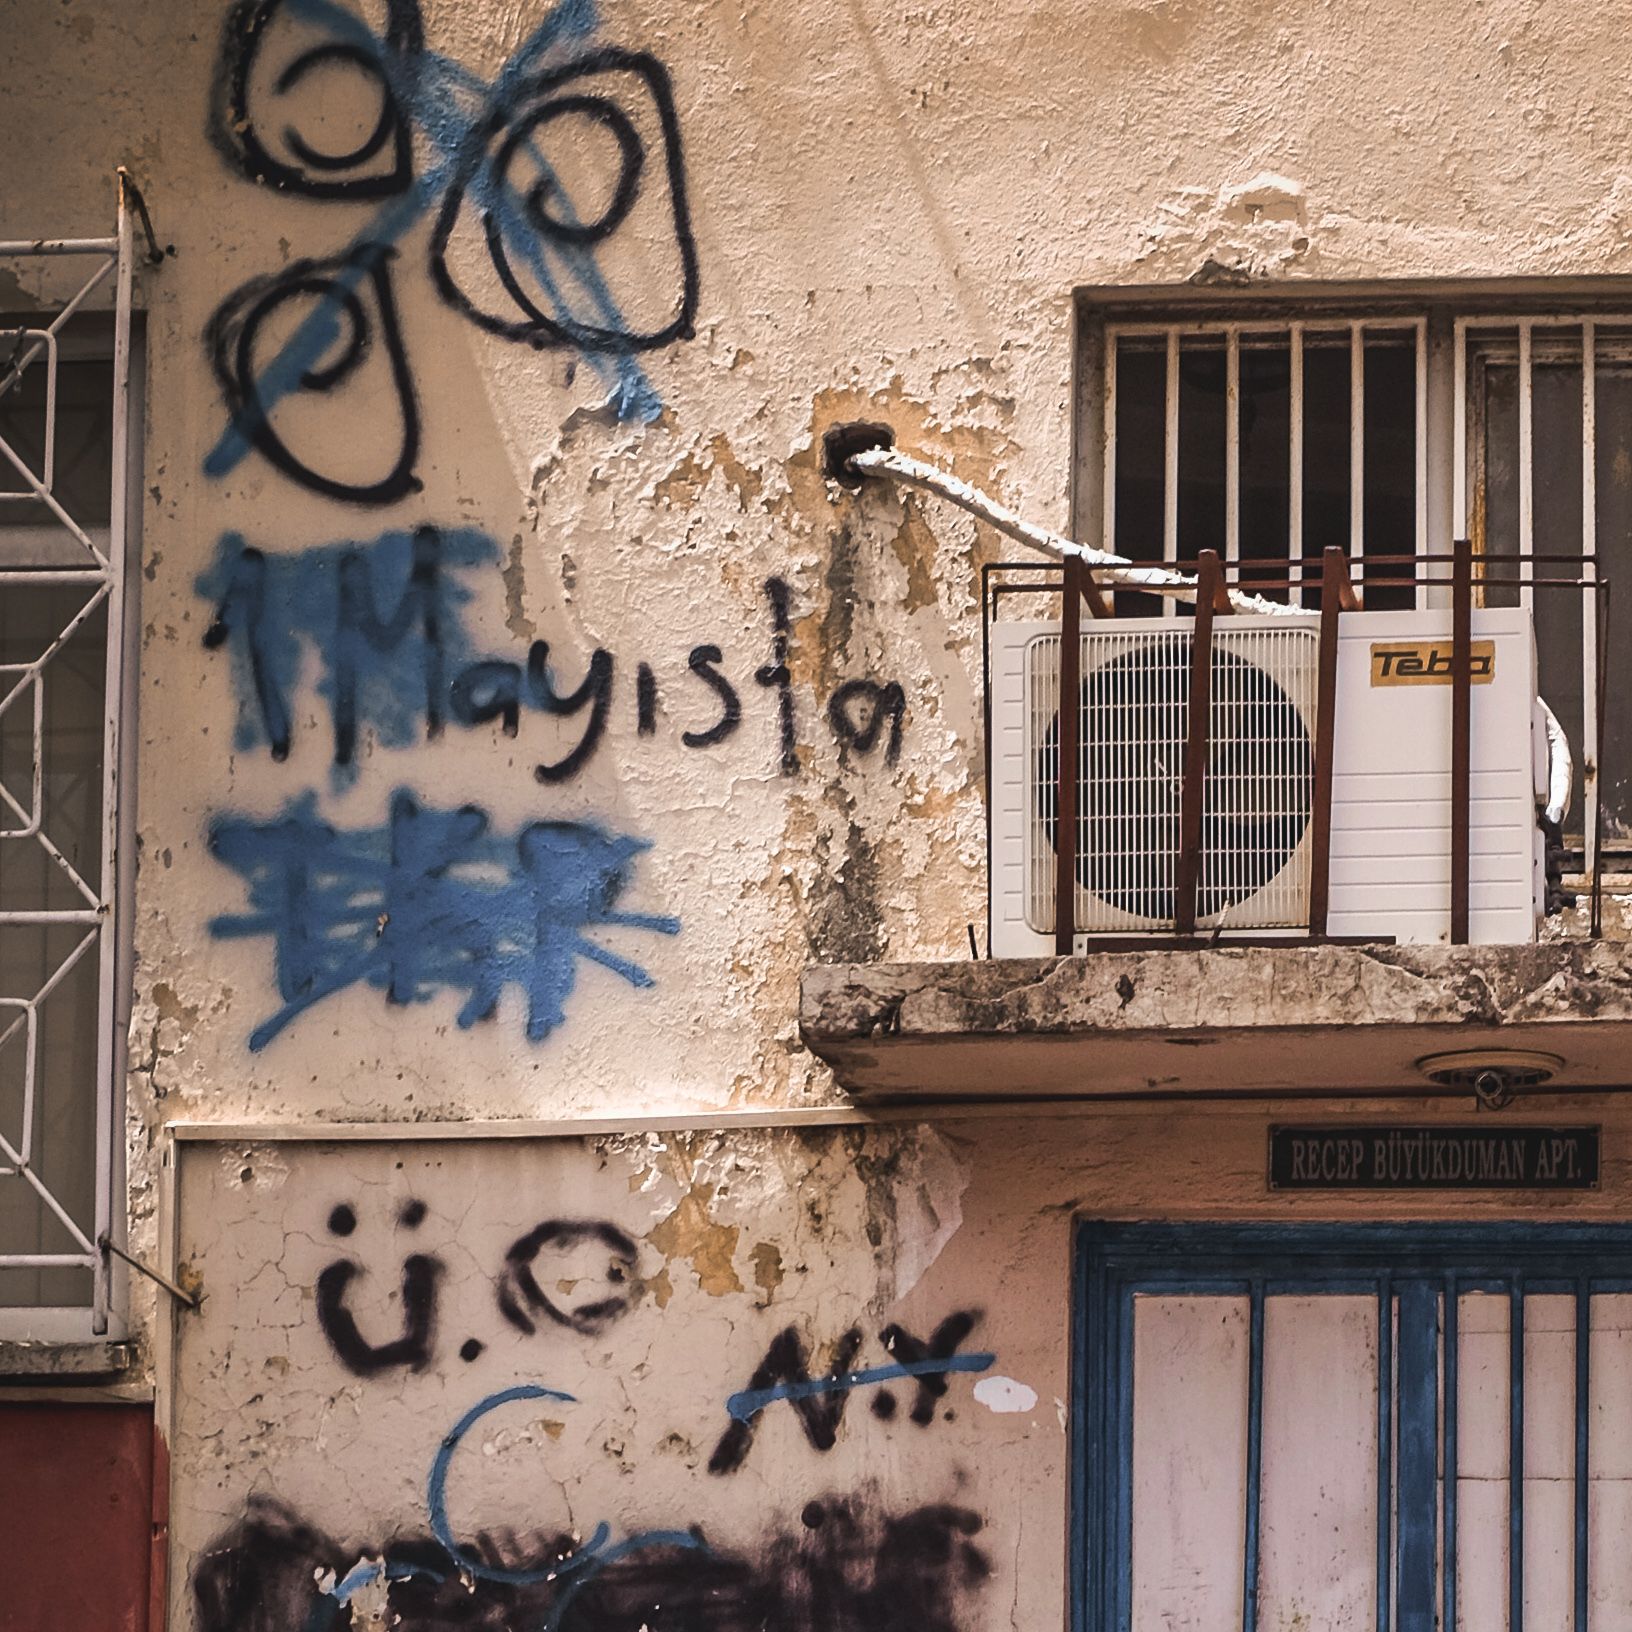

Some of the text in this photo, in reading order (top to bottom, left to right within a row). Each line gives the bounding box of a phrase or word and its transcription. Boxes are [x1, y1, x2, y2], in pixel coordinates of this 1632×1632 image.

[1374, 650, 1491, 677] Teba
[1291, 1132, 1582, 1181] RECEP BÜYÜKDUMAN APT.
